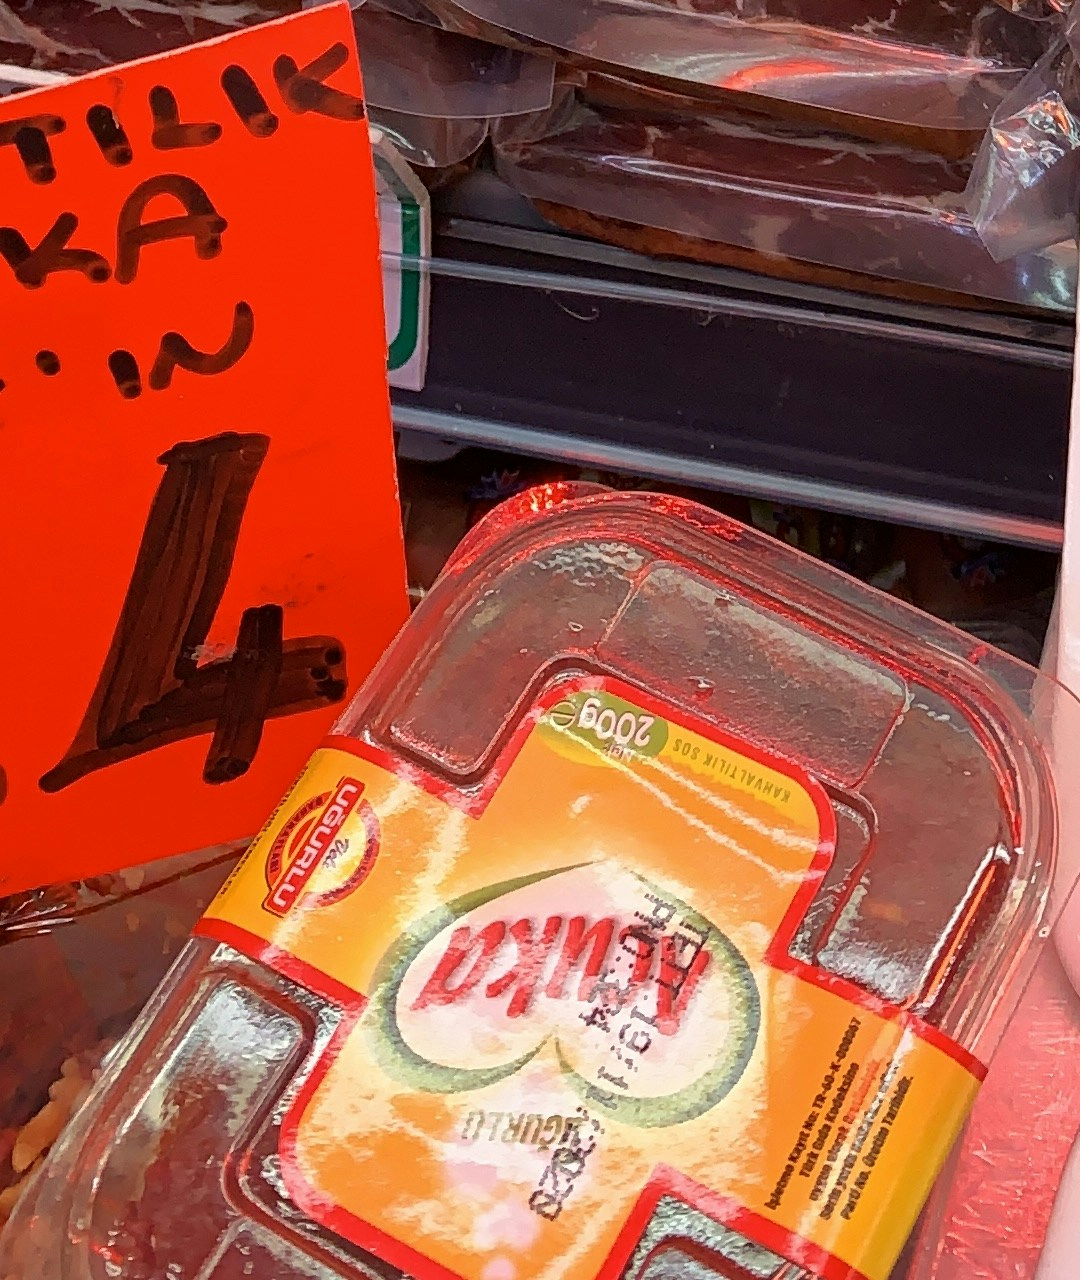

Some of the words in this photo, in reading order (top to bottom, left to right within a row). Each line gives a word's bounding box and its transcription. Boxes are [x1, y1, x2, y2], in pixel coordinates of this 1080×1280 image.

[578, 696, 656, 748] 200g
[672, 738, 700, 760] SOS
[703, 754, 792, 804] KAHVALTILIK
[271, 782, 359, 908] UĞURLU
[460, 1111, 586, 1153] UĞURLU
[799, 1151, 819, 1178] Türk
